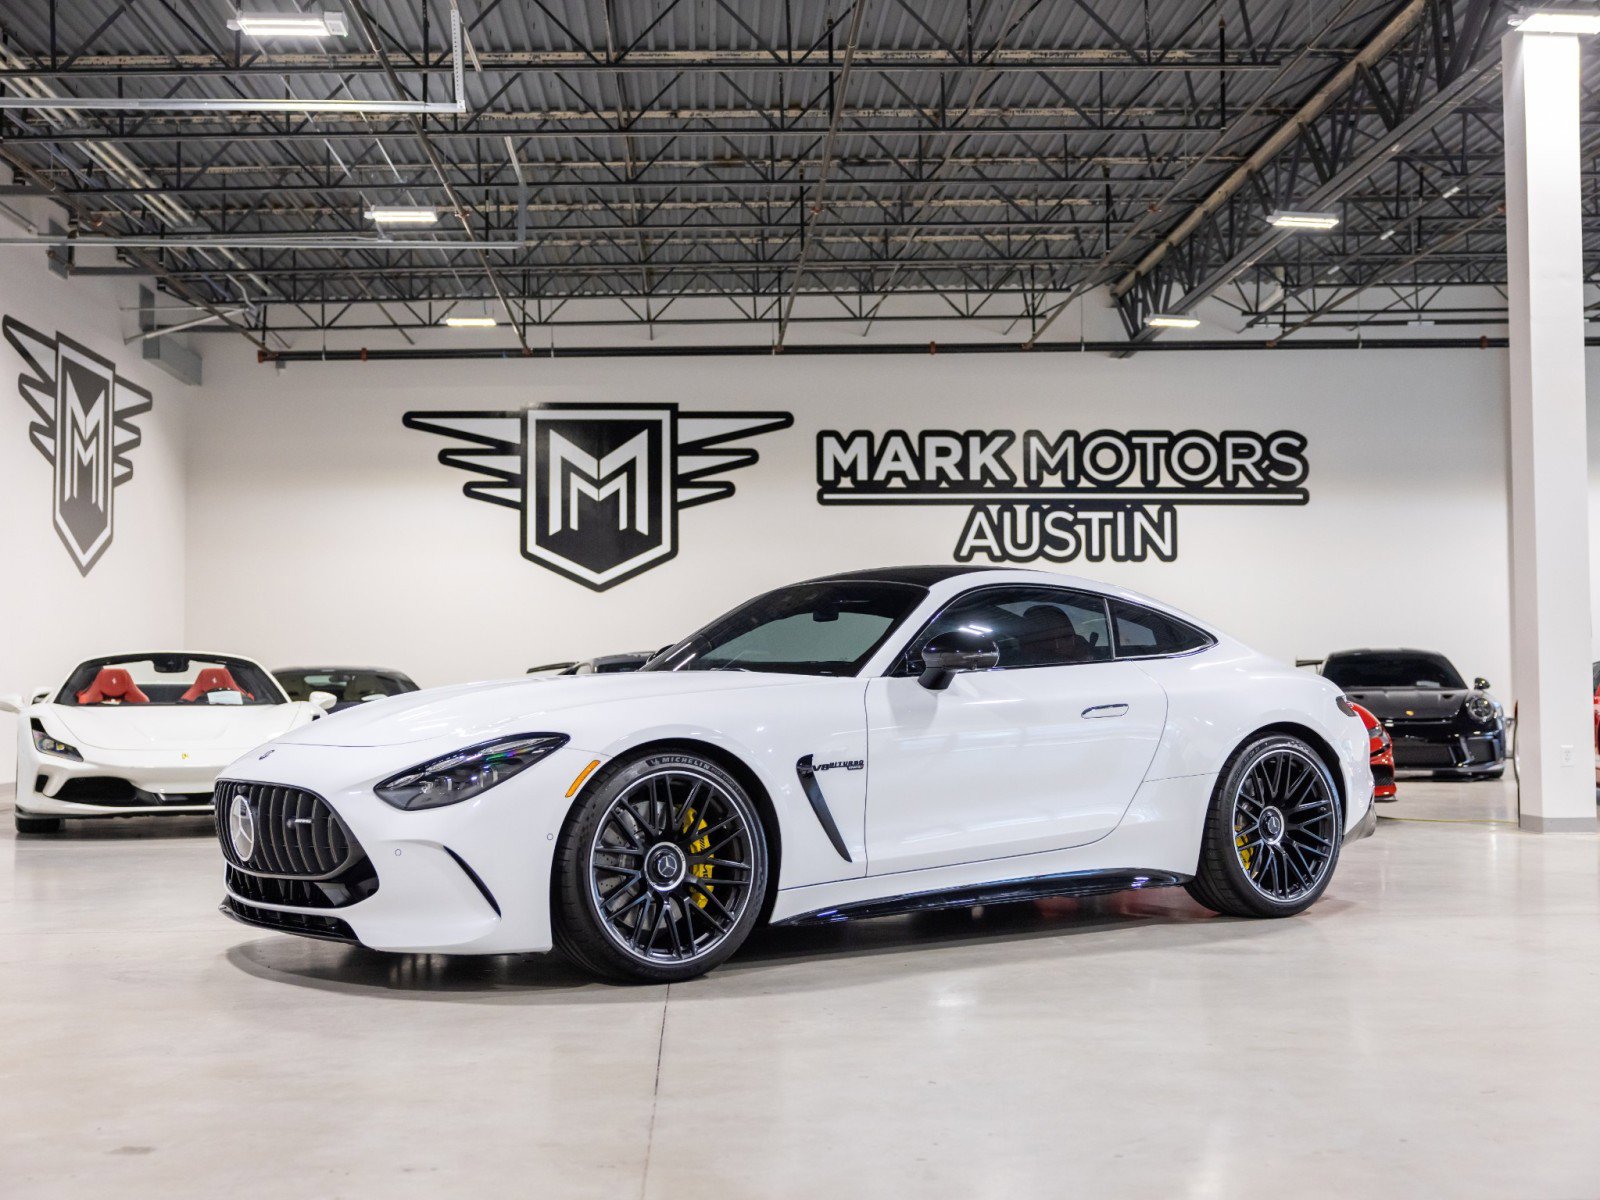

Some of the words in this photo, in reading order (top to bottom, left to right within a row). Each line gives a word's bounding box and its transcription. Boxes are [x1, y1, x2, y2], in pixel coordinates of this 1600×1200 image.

[820, 433, 1013, 484] MARK
[1027, 433, 1305, 484] MOTORS
[956, 508, 1175, 559] AUSTIN
[661, 756, 710, 770] MICHELIN
